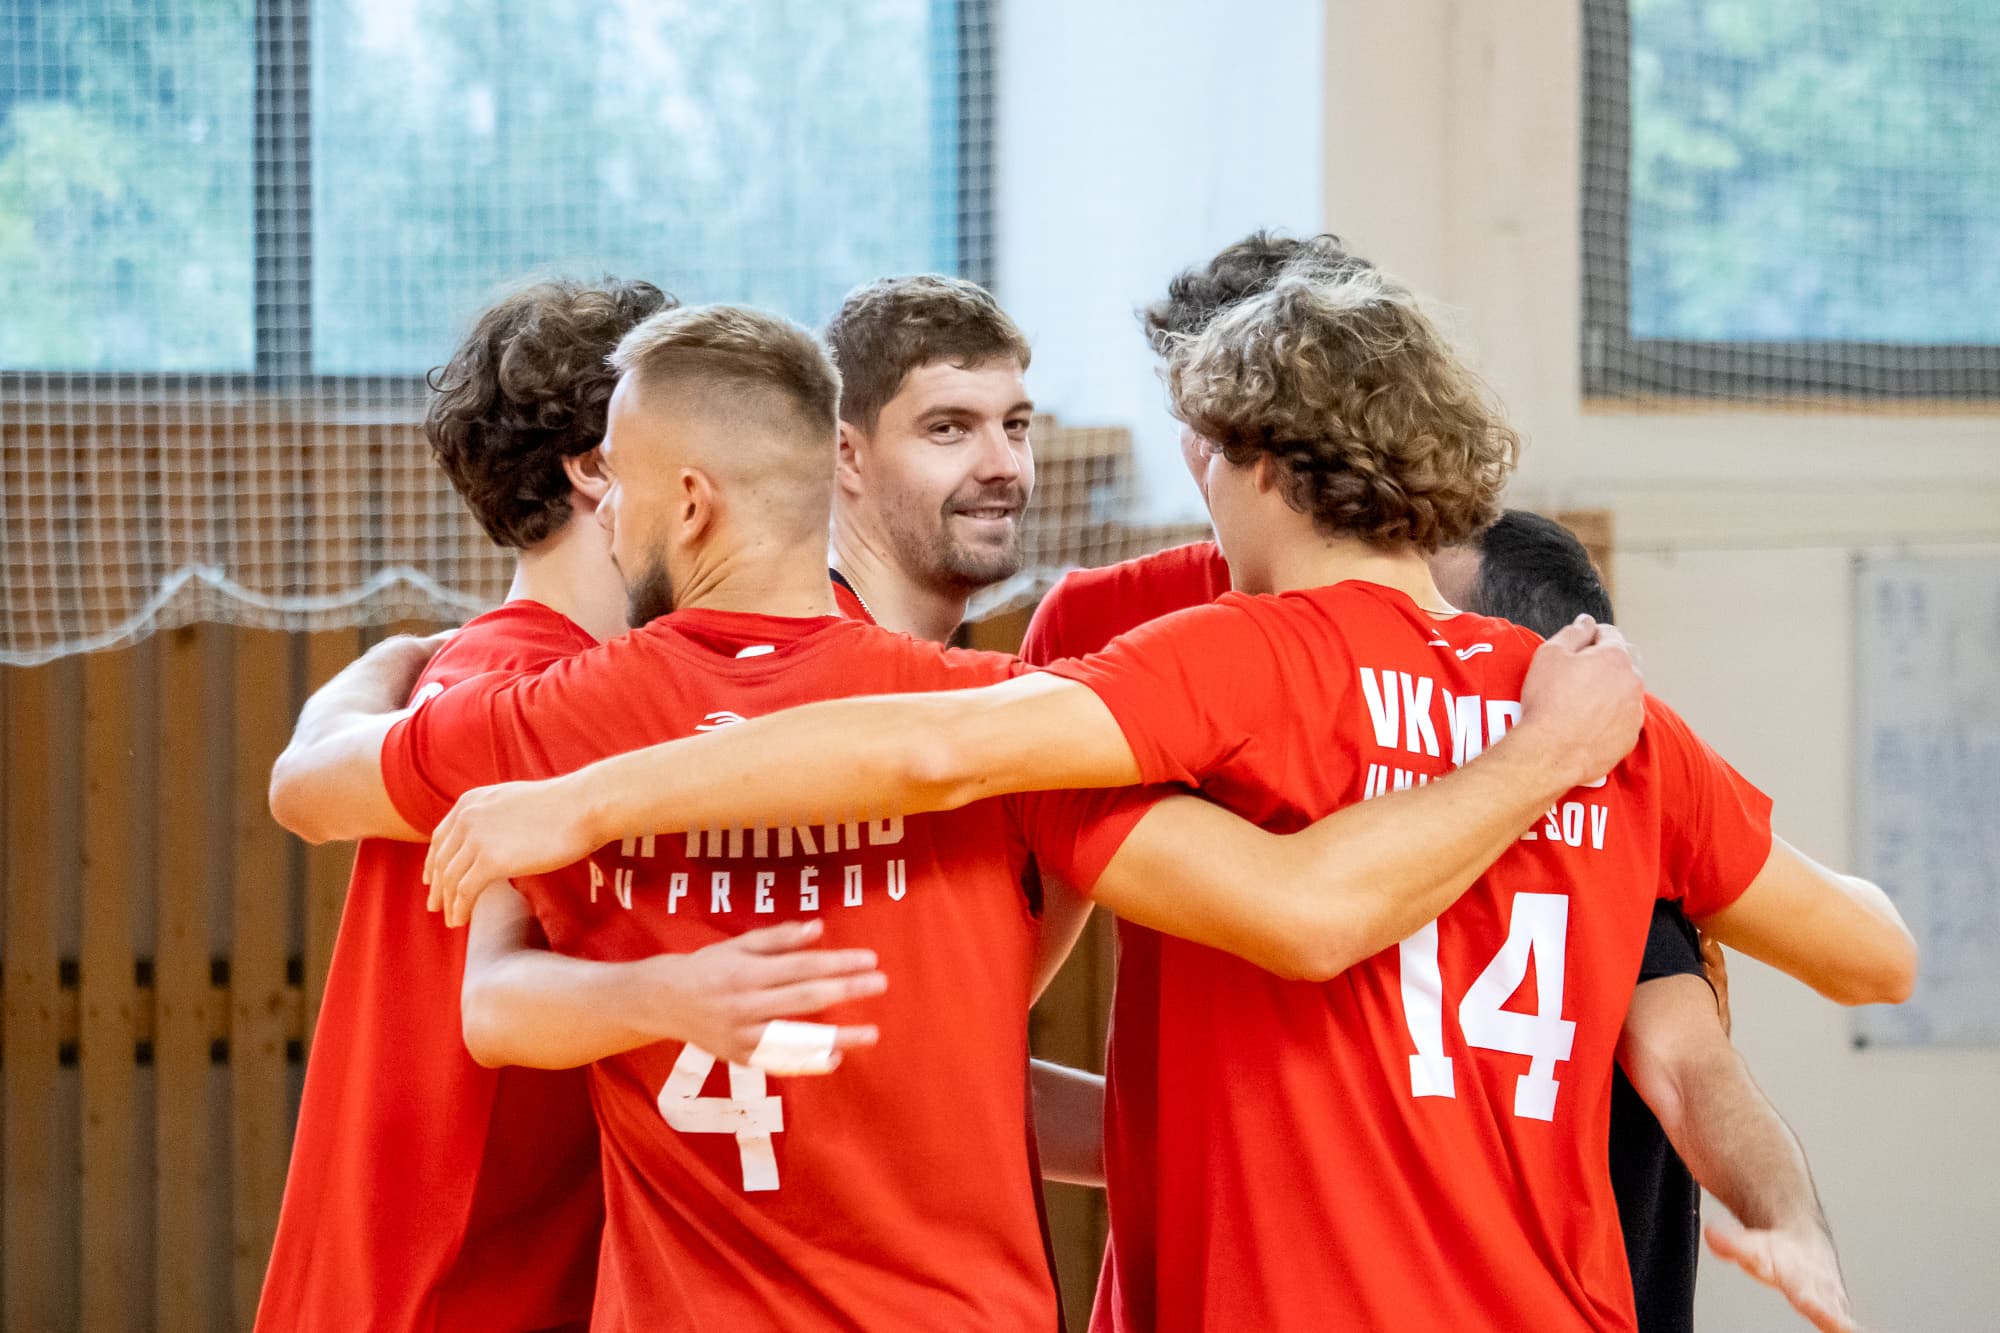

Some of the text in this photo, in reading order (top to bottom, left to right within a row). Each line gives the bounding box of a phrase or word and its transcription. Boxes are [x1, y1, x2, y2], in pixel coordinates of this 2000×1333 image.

[1359, 667, 1441, 758] VK
[667, 858, 907, 915] PREŠOV
[1399, 891, 1577, 1122] 14
[657, 1041, 785, 1192] 4
